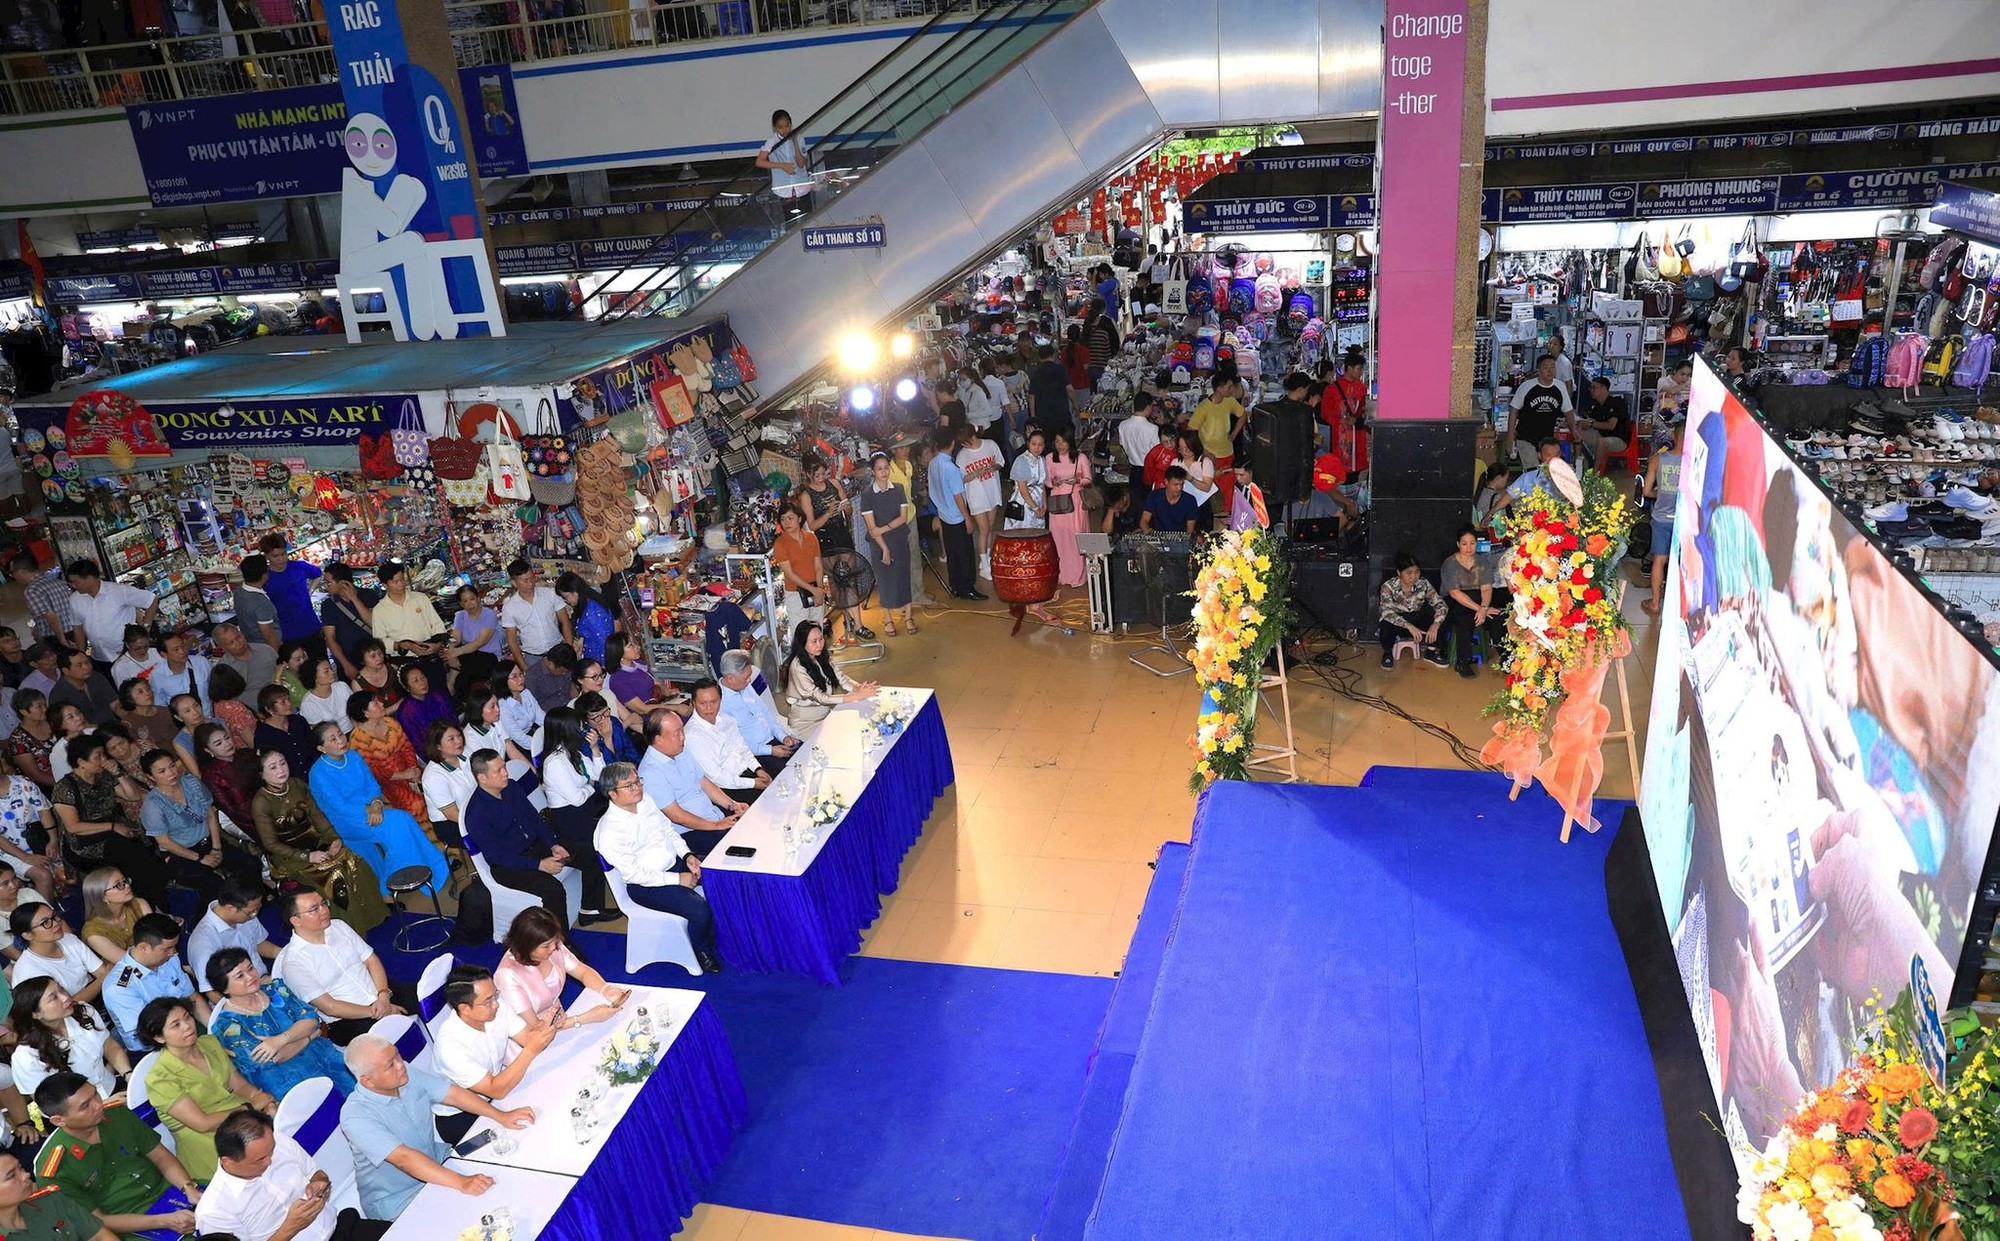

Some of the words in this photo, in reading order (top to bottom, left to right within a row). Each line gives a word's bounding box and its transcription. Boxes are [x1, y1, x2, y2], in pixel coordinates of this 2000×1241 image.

[1393, 14, 1462, 38] Change
[349, 52, 395, 87] THẢI
[1391, 55, 1431, 79] toge
[154, 109, 196, 124] VNPT
[235, 108, 271, 130] NHÀ
[271, 104, 320, 127] MẠNG
[187, 141, 227, 162] PHỤC
[227, 141, 248, 159] VỤ
[249, 136, 281, 157] TẬN
[281, 133, 317, 151] TÂM
[1614, 142, 1641, 154] LINH
[437, 161, 468, 182] waste
[1297, 158, 1340, 169] CHINH
[267, 180, 300, 192] VNPT
[1848, 169, 1940, 188] CƯỜNG
[1533, 187, 1564, 204] THÚY
[1565, 188, 1603, 202] CHINH
[1658, 181, 1713, 198] PHƯƠNG
[1713, 179, 1762, 195] NHUNG
[606, 206, 625, 215] VINH
[1214, 198, 1250, 216] THỦY
[1255, 199, 1286, 215] ĐỨC
[825, 230, 854, 245] THANG
[855, 227, 868, 244] SỐ
[869, 230, 881, 243] 10
[594, 242, 614, 253] HUY
[616, 238, 653, 252] QUANG
[497, 249, 525, 261] QUANG
[237, 268, 255, 278] THU
[237, 407, 319, 427] XUAN
[326, 404, 384, 424] ART
[180, 427, 293, 442] Souvenirs
[300, 426, 362, 438] Shop
